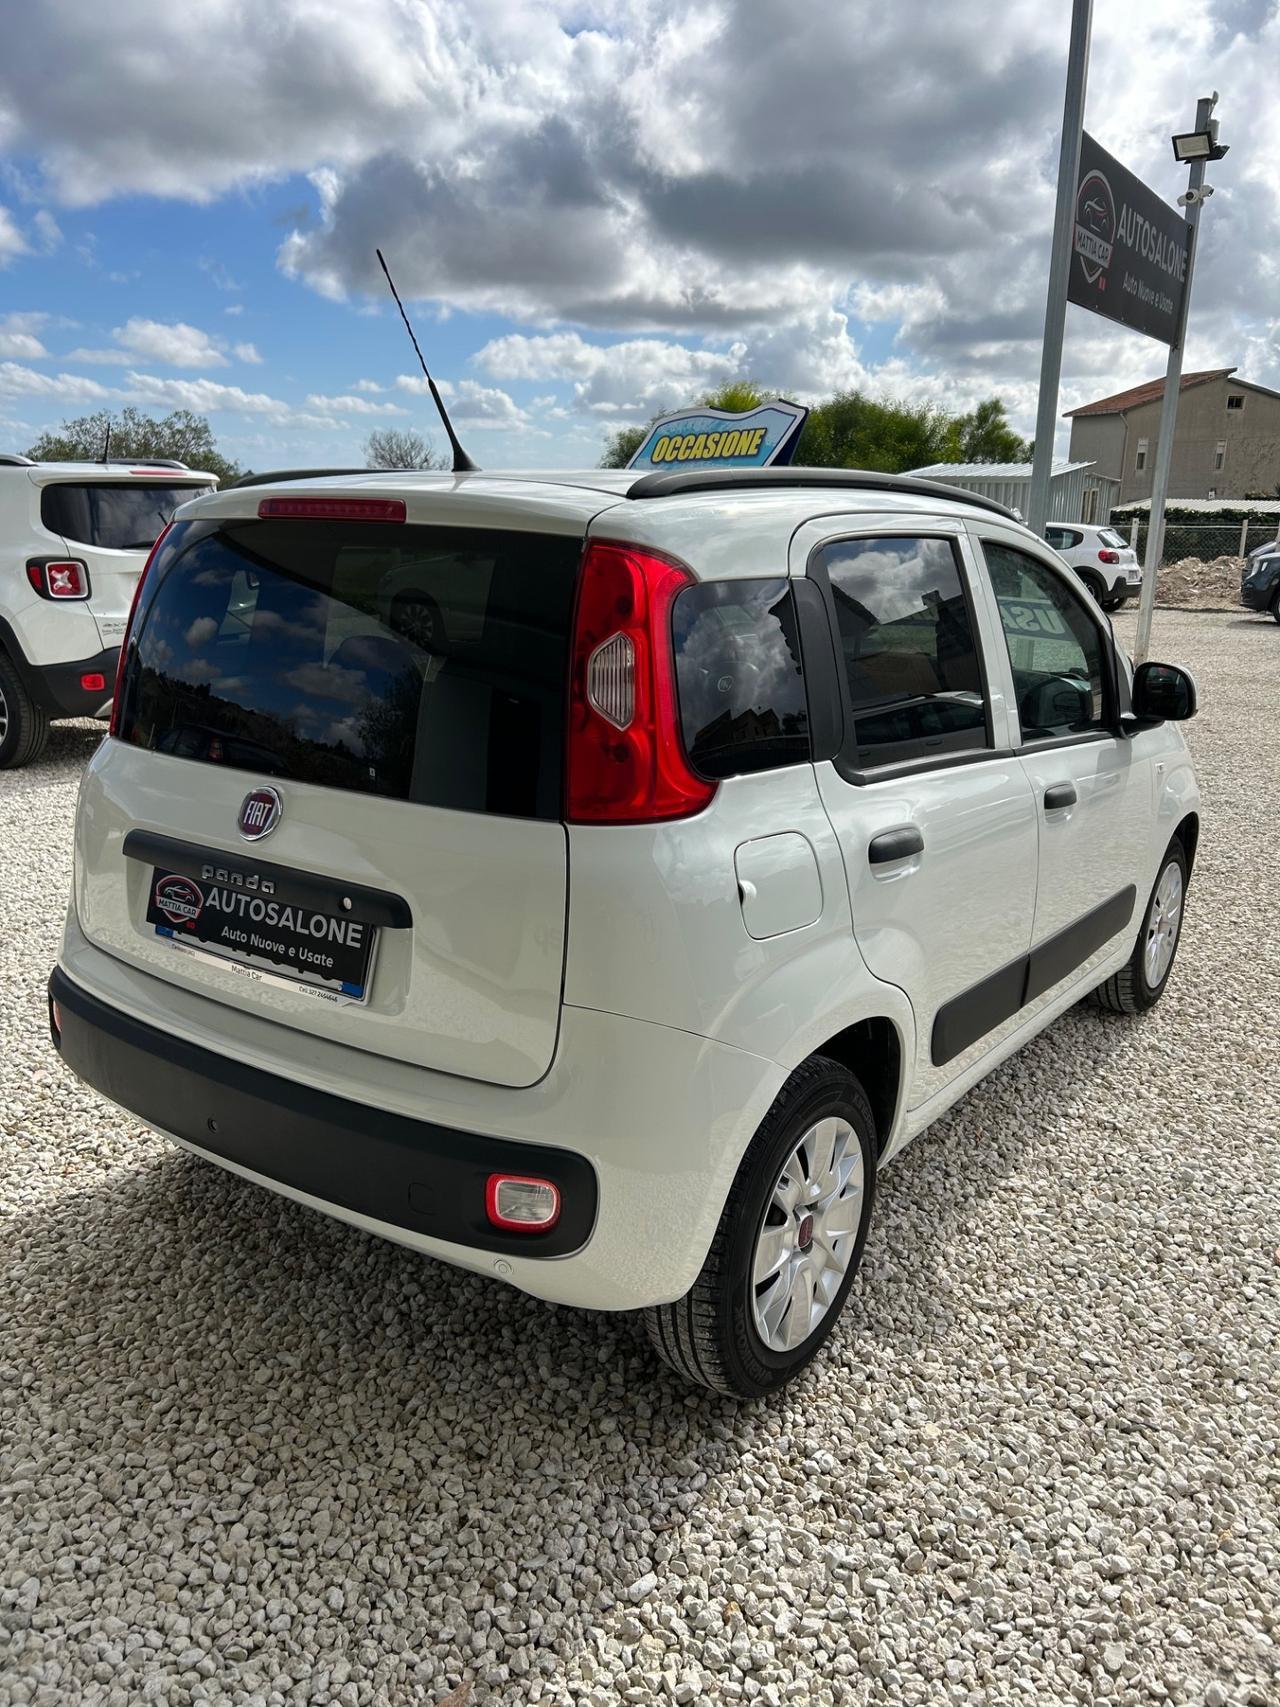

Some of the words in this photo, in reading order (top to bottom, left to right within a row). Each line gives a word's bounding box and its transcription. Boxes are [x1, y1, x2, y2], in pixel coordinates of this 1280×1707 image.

[1117, 203, 1188, 282] AUTOSALONE
[1122, 271, 1138, 296] Auto
[1138, 279, 1155, 305] Nuove
[1154, 292, 1160, 307] e
[652, 428, 767, 464] OCCASIONE
[242, 800, 272, 827] FIAT
[201, 864, 276, 894] panda
[158, 898, 182, 913] MATTIA
[182, 906, 197, 917] CAR
[205, 887, 363, 948] AUTOSALONE
[221, 926, 248, 943] Auto
[250, 933, 285, 955] Nuove
[288, 946, 296, 957] e
[298, 947, 334, 968] Usate
[231, 964, 251, 979] Mattia
[251, 970, 263, 982] Car
